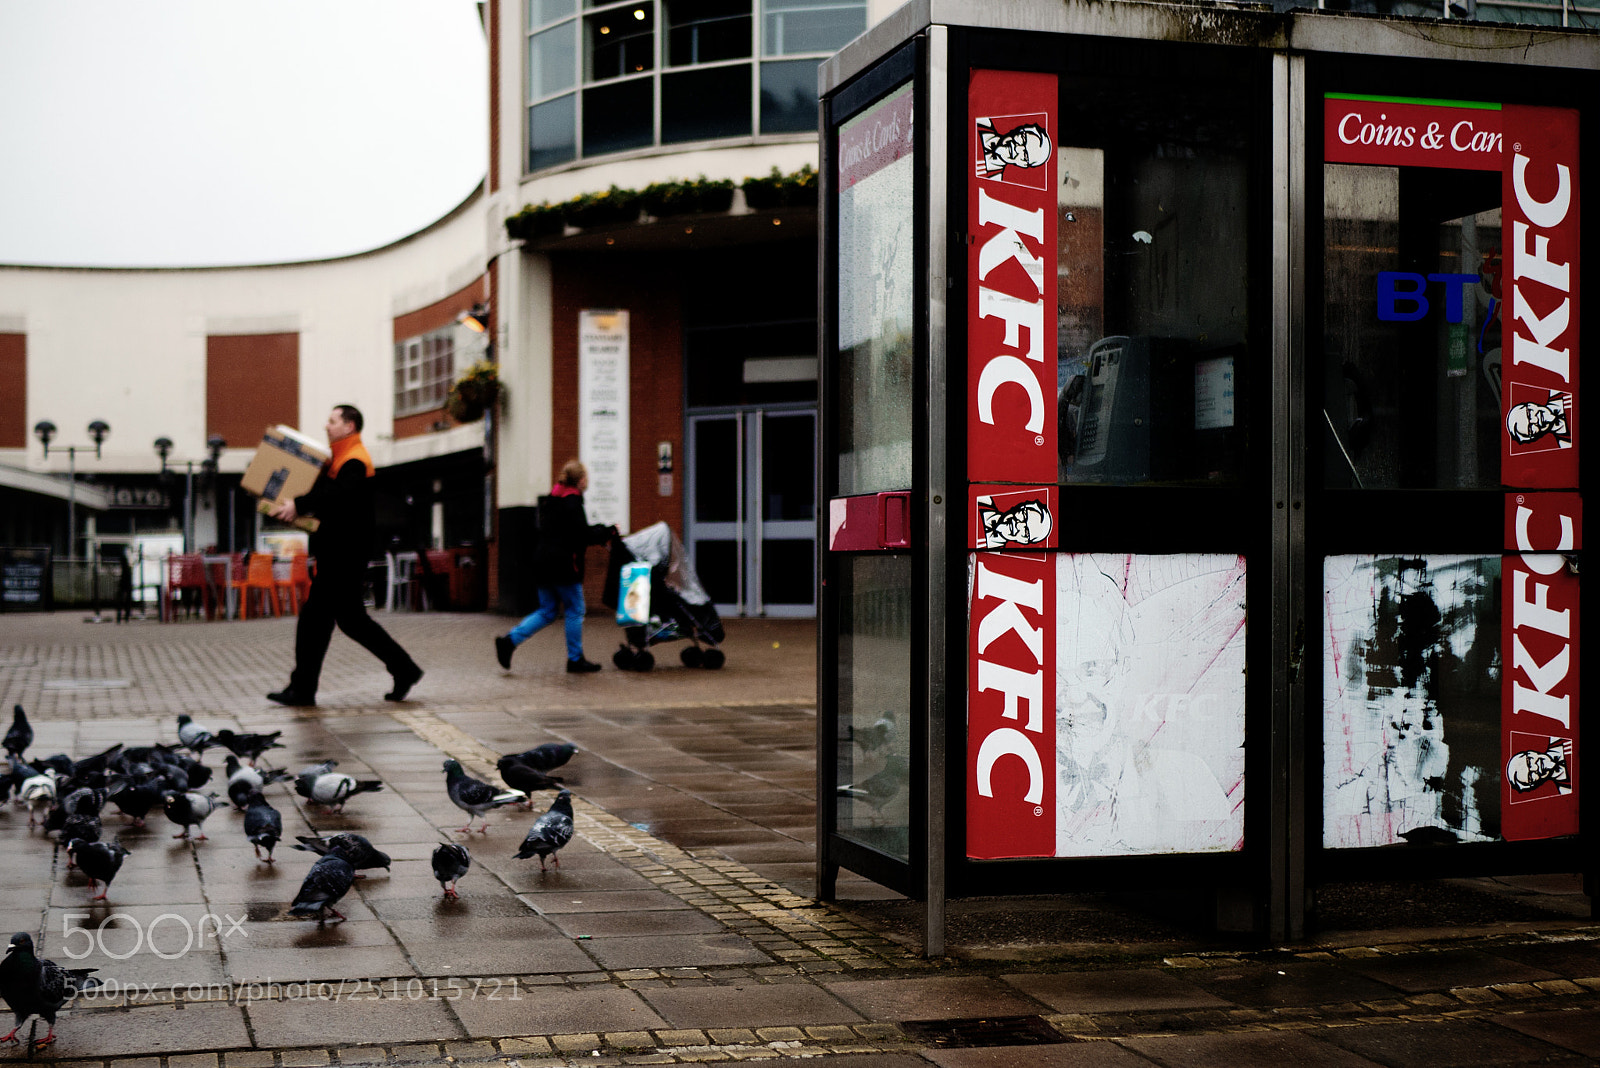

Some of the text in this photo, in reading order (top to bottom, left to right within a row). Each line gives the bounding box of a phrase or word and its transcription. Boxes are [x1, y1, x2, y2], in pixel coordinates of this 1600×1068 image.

[1337, 112, 1417, 148] Coins
[1420, 121, 1446, 150] &
[1376, 271, 1480, 323] BT
